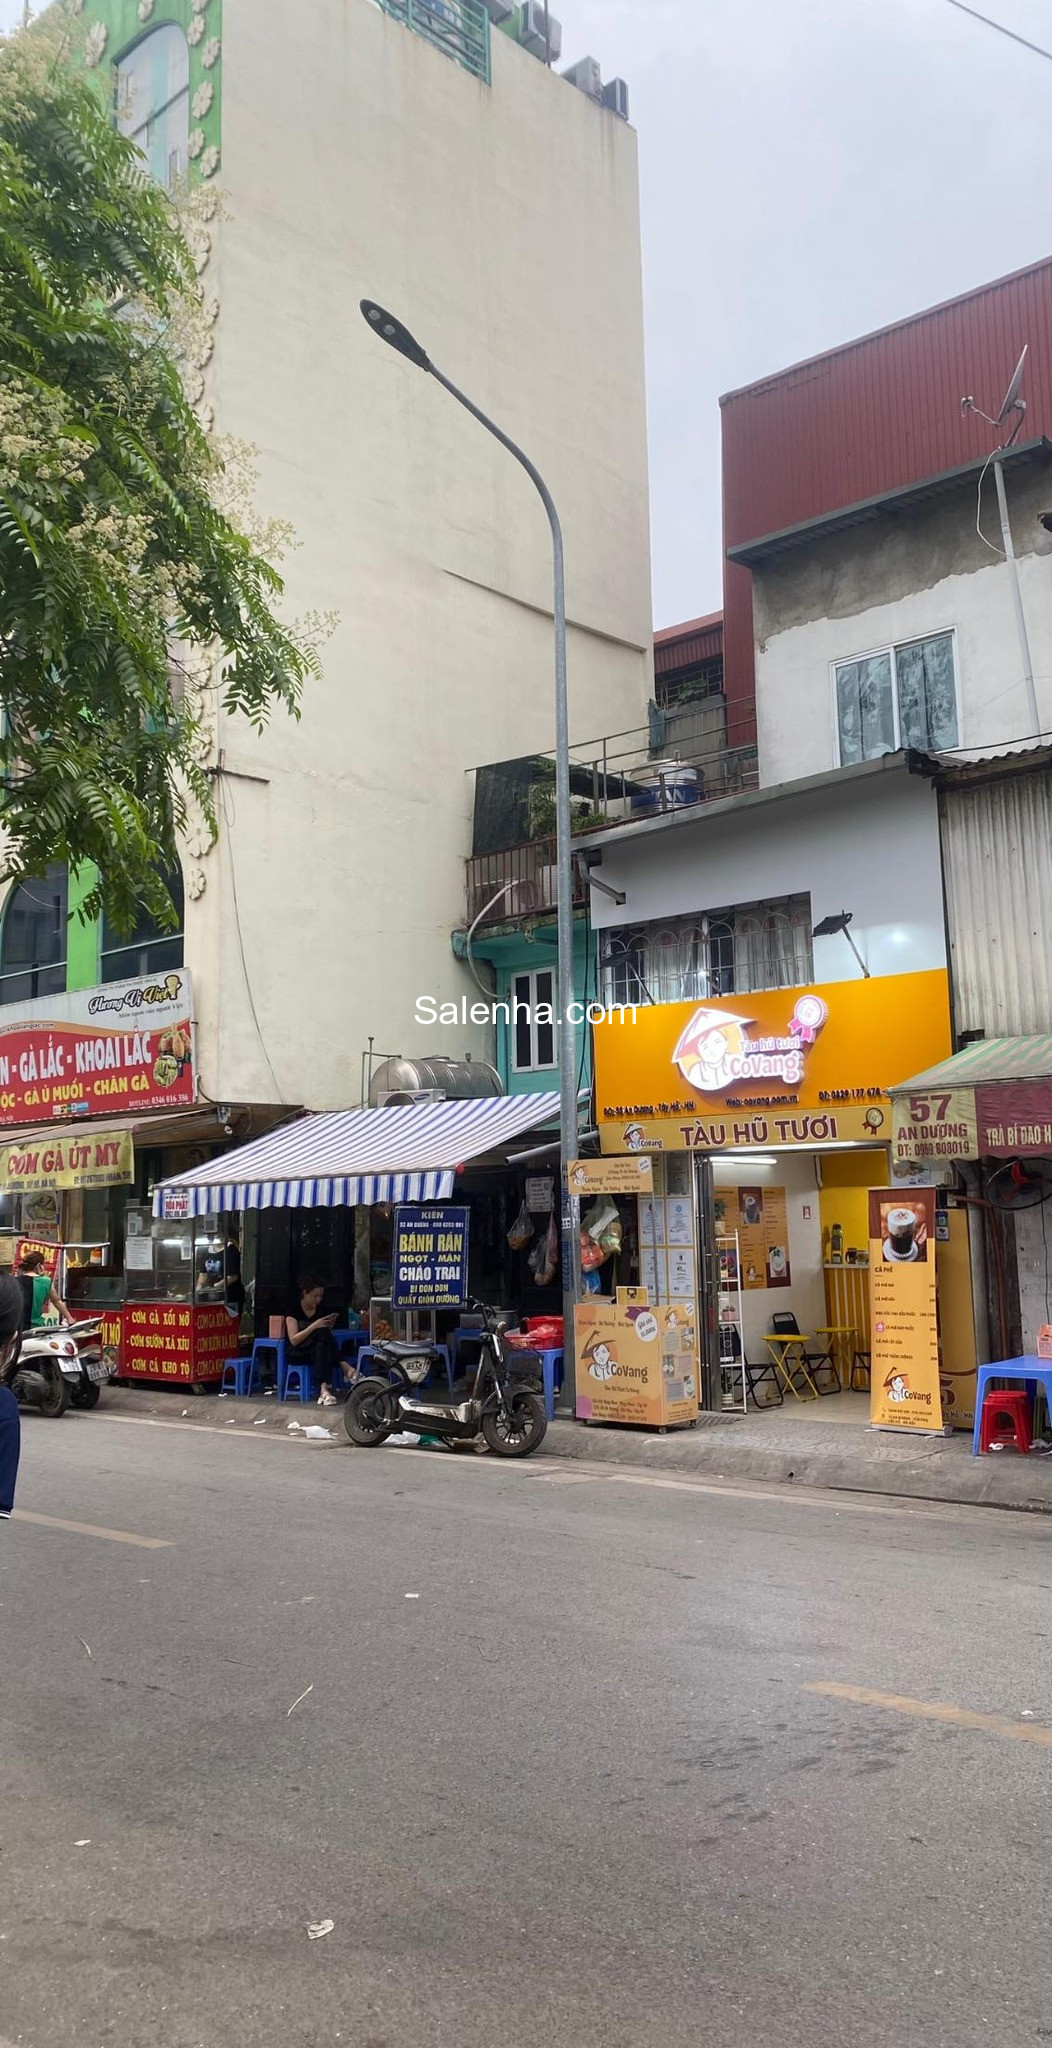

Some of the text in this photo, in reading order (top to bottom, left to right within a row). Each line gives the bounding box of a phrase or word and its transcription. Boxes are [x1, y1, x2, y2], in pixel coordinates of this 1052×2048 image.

[20, 1044, 38, 1082] GÀ
[40, 1034, 64, 1079] LẮC
[75, 1036, 121, 1073] KHOAI
[124, 1018, 152, 1067] LẮC
[24, 1087, 40, 1105] GÀ
[53, 1078, 83, 1102] MUỐI
[94, 1075, 128, 1096] CHÂN
[131, 1070, 150, 1091] GÀ
[851, 1089, 865, 1098] 177
[910, 1095, 952, 1122] 57
[680, 1116, 838, 1146] TÀU HŨ TƯƠI
[897, 1122, 968, 1140] AN DƯƠNG
[987, 1123, 1005, 1147] TRÀ
[1007, 1122, 1018, 1146] BÍ
[42, 1143, 64, 1173] GÀ
[69, 1140, 91, 1170] ÚT
[95, 1141, 121, 1167] MY
[914, 1142, 934, 1156] 0969
[399, 1231, 463, 1252] BÁNH RÁN
[400, 1254, 428, 1264] NGỌT
[400, 1264, 460, 1281] CHÁO TRAI
[149, 1309, 160, 1325] GÀ
[149, 1358, 159, 1373] CÁ
[162, 1361, 177, 1374] KHO
[611, 1363, 648, 1383] CoVang
[904, 1390, 932, 1405] CoVang
